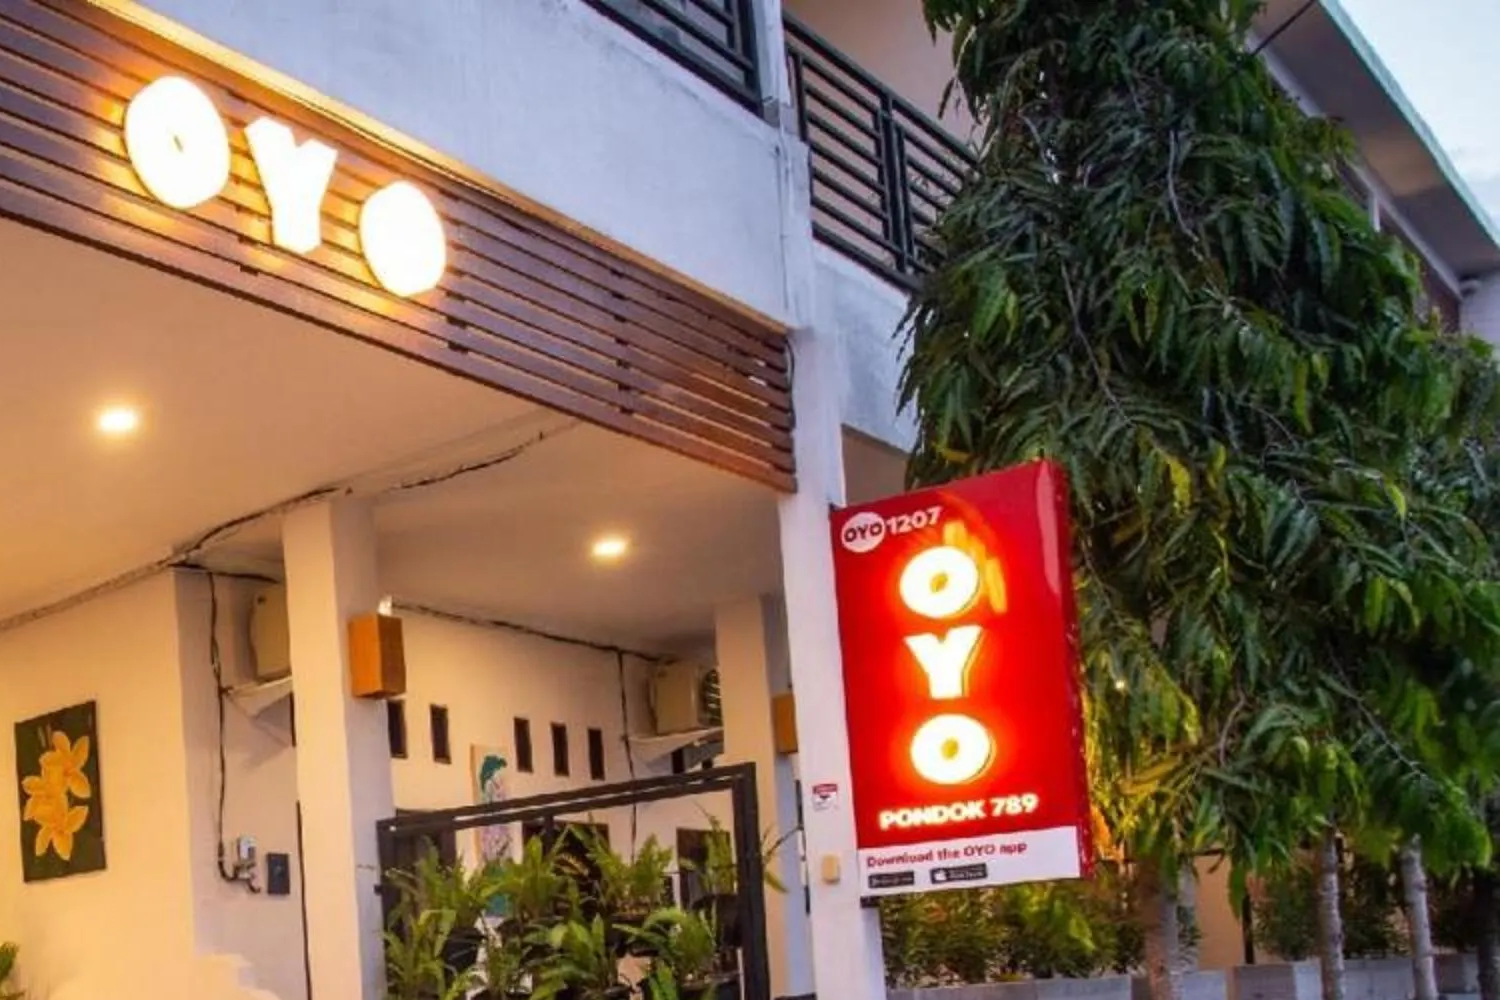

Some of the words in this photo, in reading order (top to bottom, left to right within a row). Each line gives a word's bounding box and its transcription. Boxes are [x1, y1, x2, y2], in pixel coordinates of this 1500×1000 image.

[124, 76, 446, 297] OYO
[844, 523, 882, 542] OYO
[886, 506, 942, 535] 1207
[900, 545, 991, 784] OYO
[879, 800, 985, 830] PONDOK
[990, 793, 1038, 816] 789
[867, 851, 933, 868] Download
[938, 847, 960, 860] the
[964, 844, 996, 857] OYO
[1000, 842, 1028, 856] app
